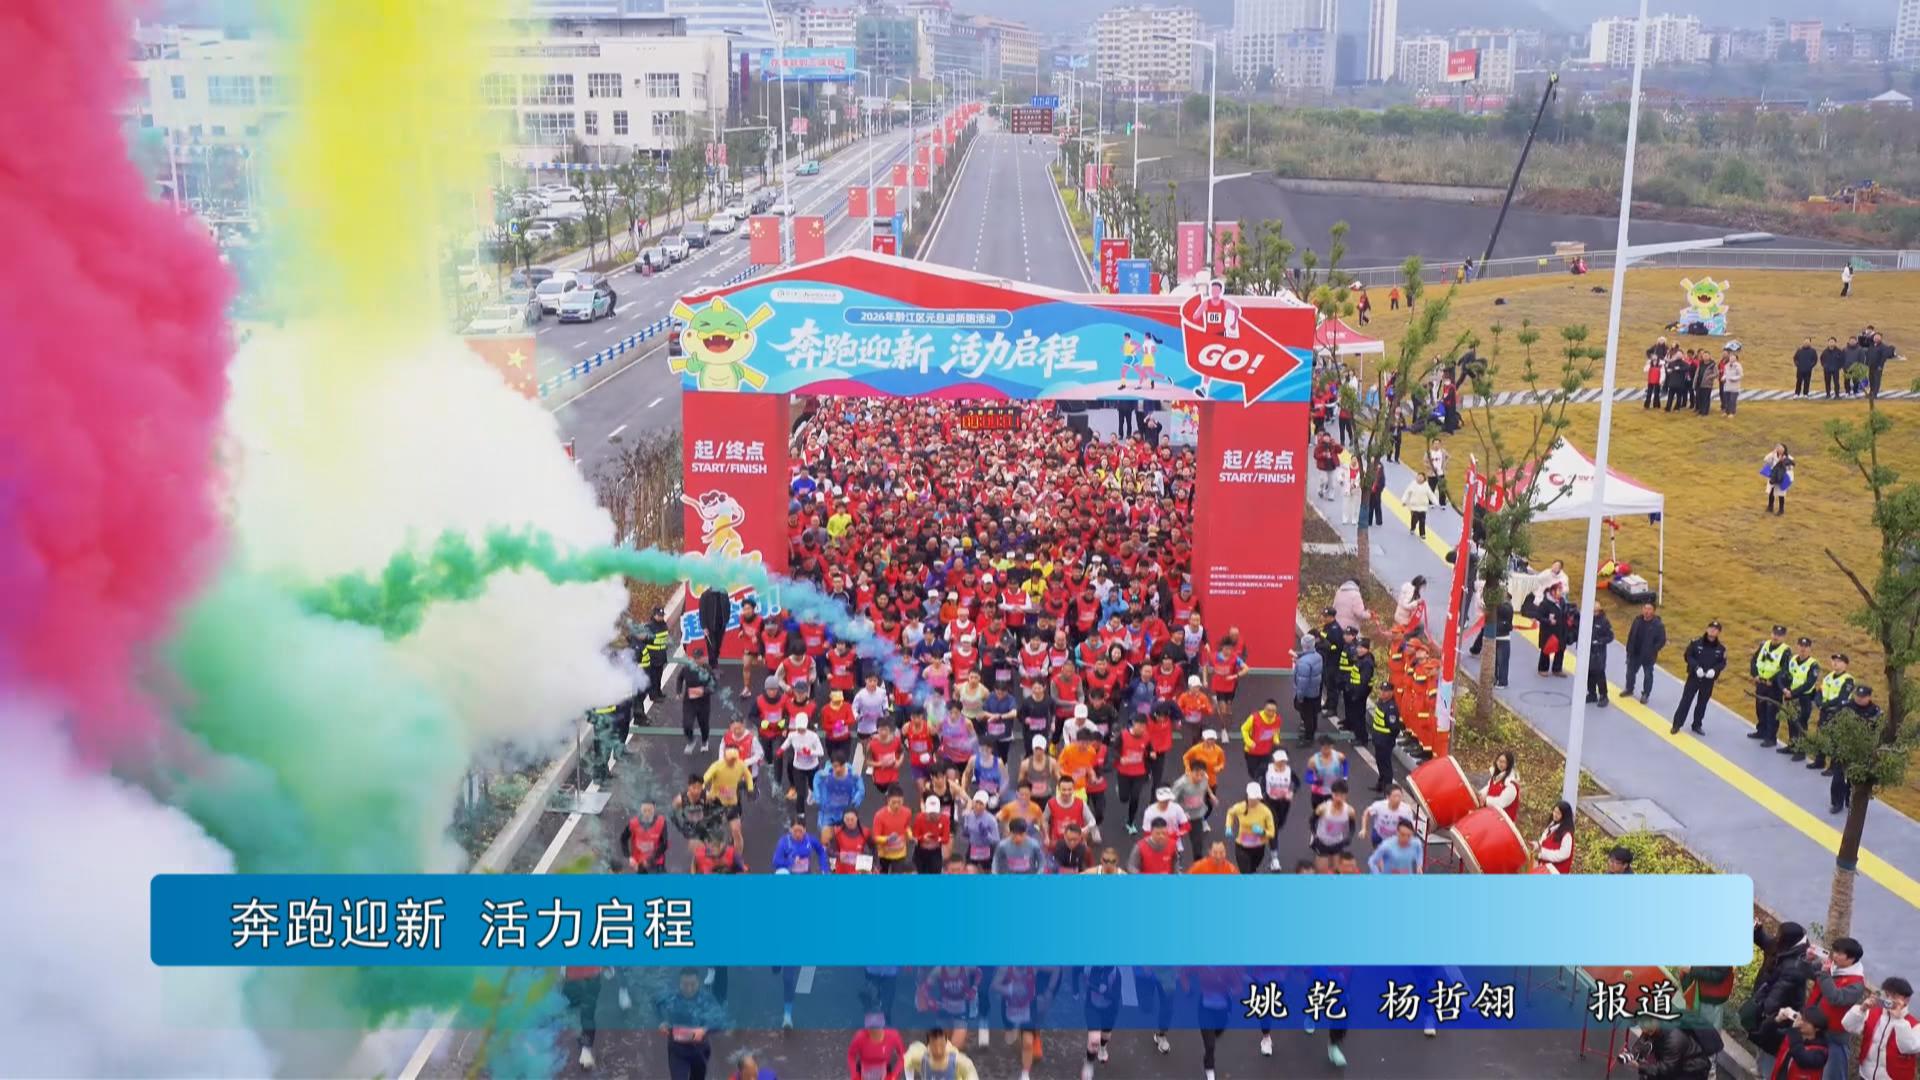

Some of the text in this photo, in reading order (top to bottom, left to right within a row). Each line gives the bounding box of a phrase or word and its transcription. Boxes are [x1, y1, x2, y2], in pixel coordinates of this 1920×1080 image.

[767, 318, 1098, 378] 奔跑迎新 活力启程
[1198, 343, 1265, 375] GO!
[694, 439, 765, 461] 起/终点
[1222, 449, 1294, 471] 起/终点
[691, 462, 768, 474] START/FINISH
[1219, 472, 1296, 483] START/FINISH
